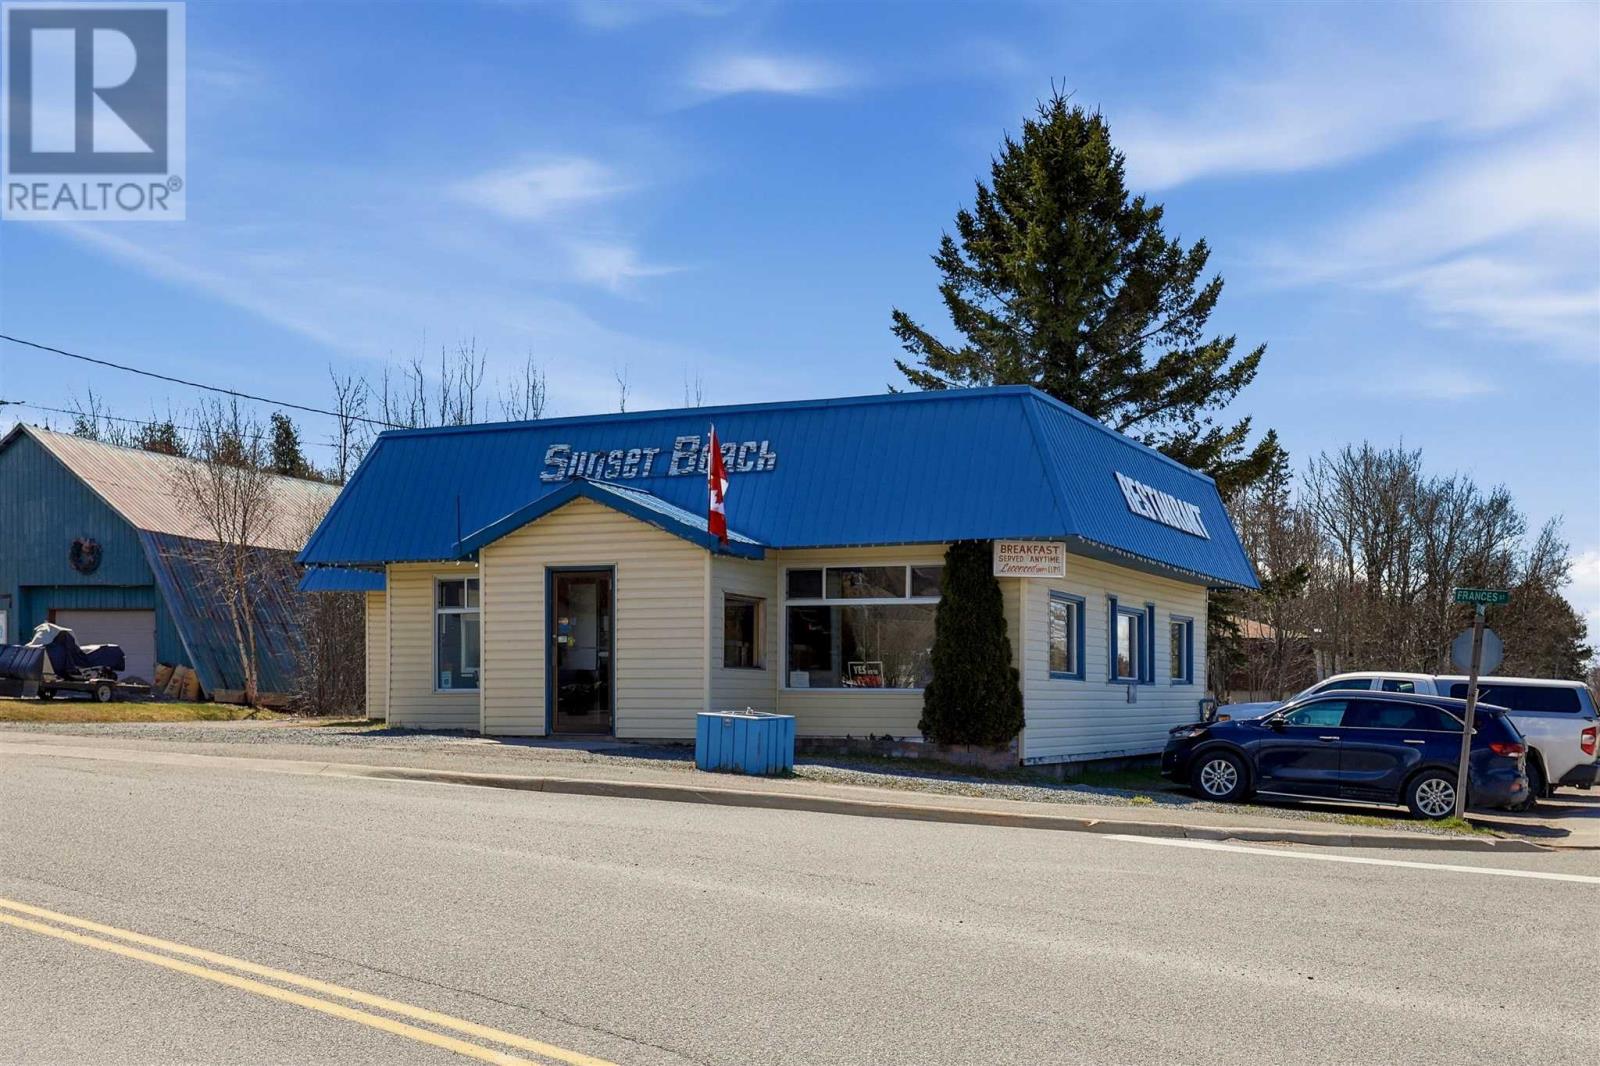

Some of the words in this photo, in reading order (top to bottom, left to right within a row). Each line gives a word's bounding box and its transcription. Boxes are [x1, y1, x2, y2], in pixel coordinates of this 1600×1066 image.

[540, 444, 660, 482] Sunset
[1114, 470, 1211, 540] RESTAURANT
[1000, 544, 1060, 555] BREAKFAST
[998, 555, 1024, 563] SERVED
[1029, 555, 1061, 564] ANYTIME
[1457, 590, 1498, 602] FRANCES
